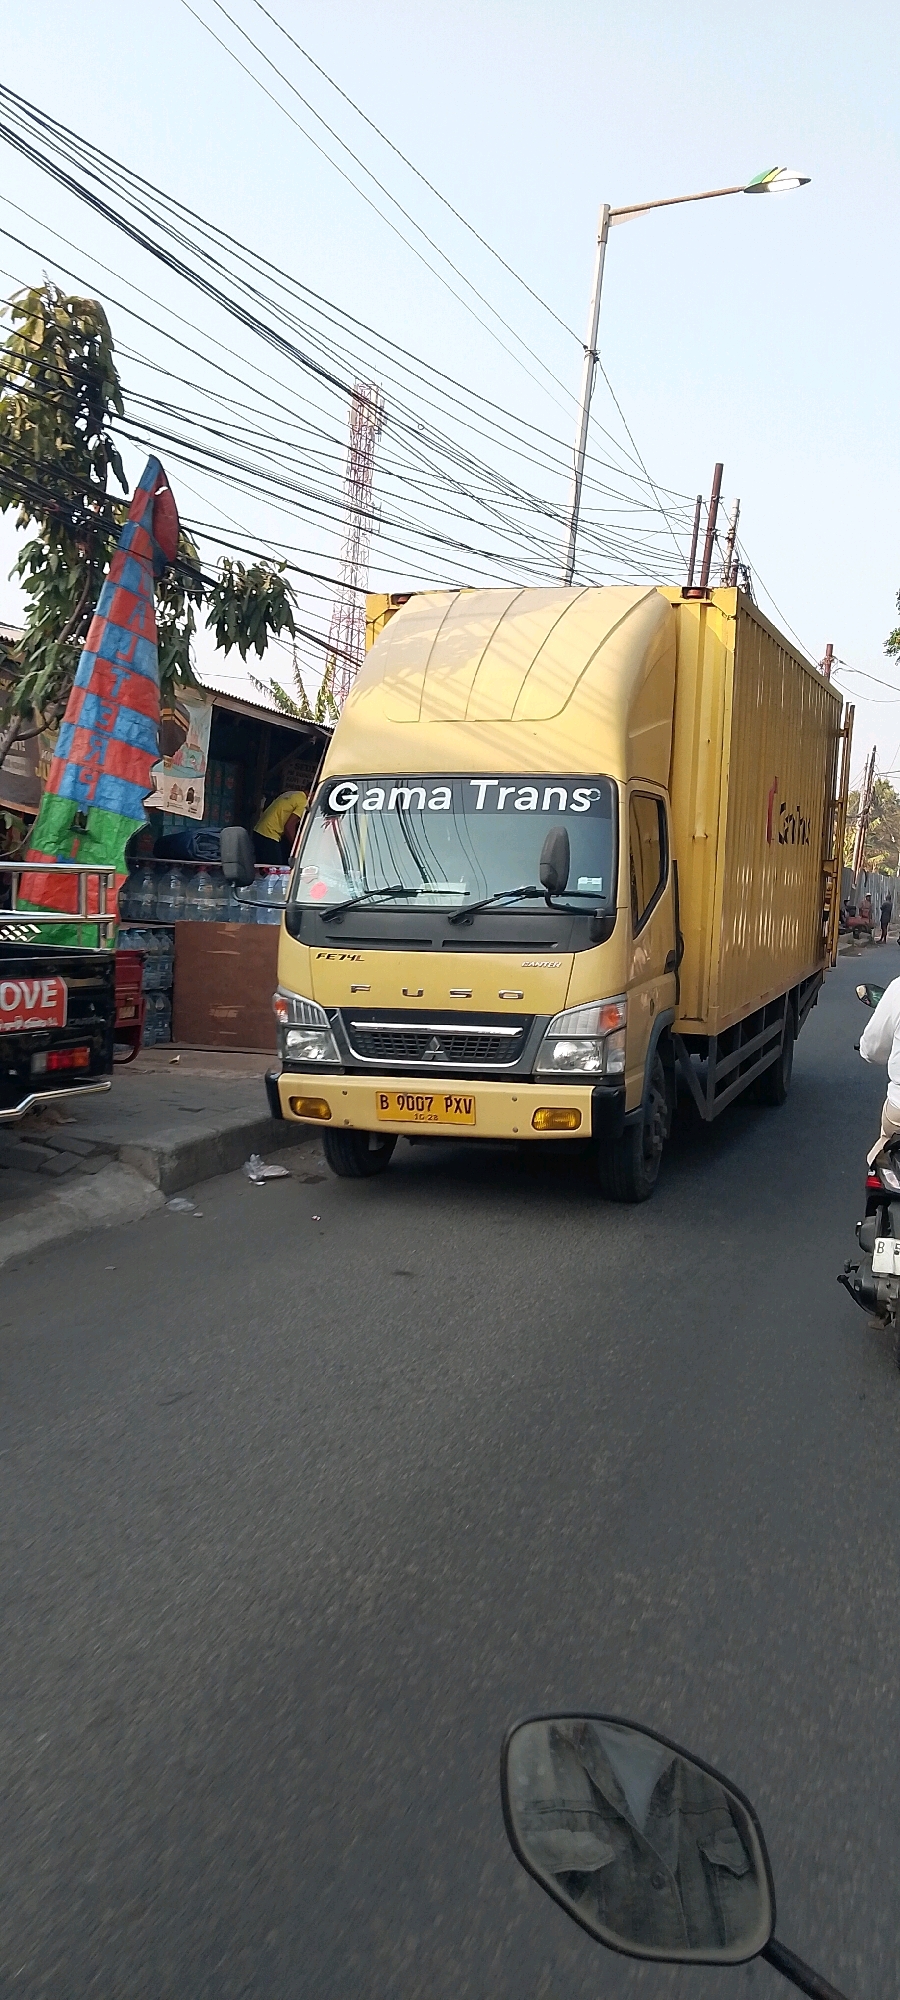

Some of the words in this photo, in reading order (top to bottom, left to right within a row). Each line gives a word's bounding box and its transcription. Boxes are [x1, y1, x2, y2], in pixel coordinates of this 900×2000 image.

[328, 781, 453, 813] Gama
[468, 779, 593, 813] Trans
[315, 952, 365, 962] FE74L
[521, 961, 562, 969] CANTER
[350, 984, 524, 1000] FUSO
[379, 1094, 389, 1110] B
[397, 1094, 434, 1112] 9007
[444, 1095, 472, 1115] PXV
[877, 1241, 885, 1254] B
